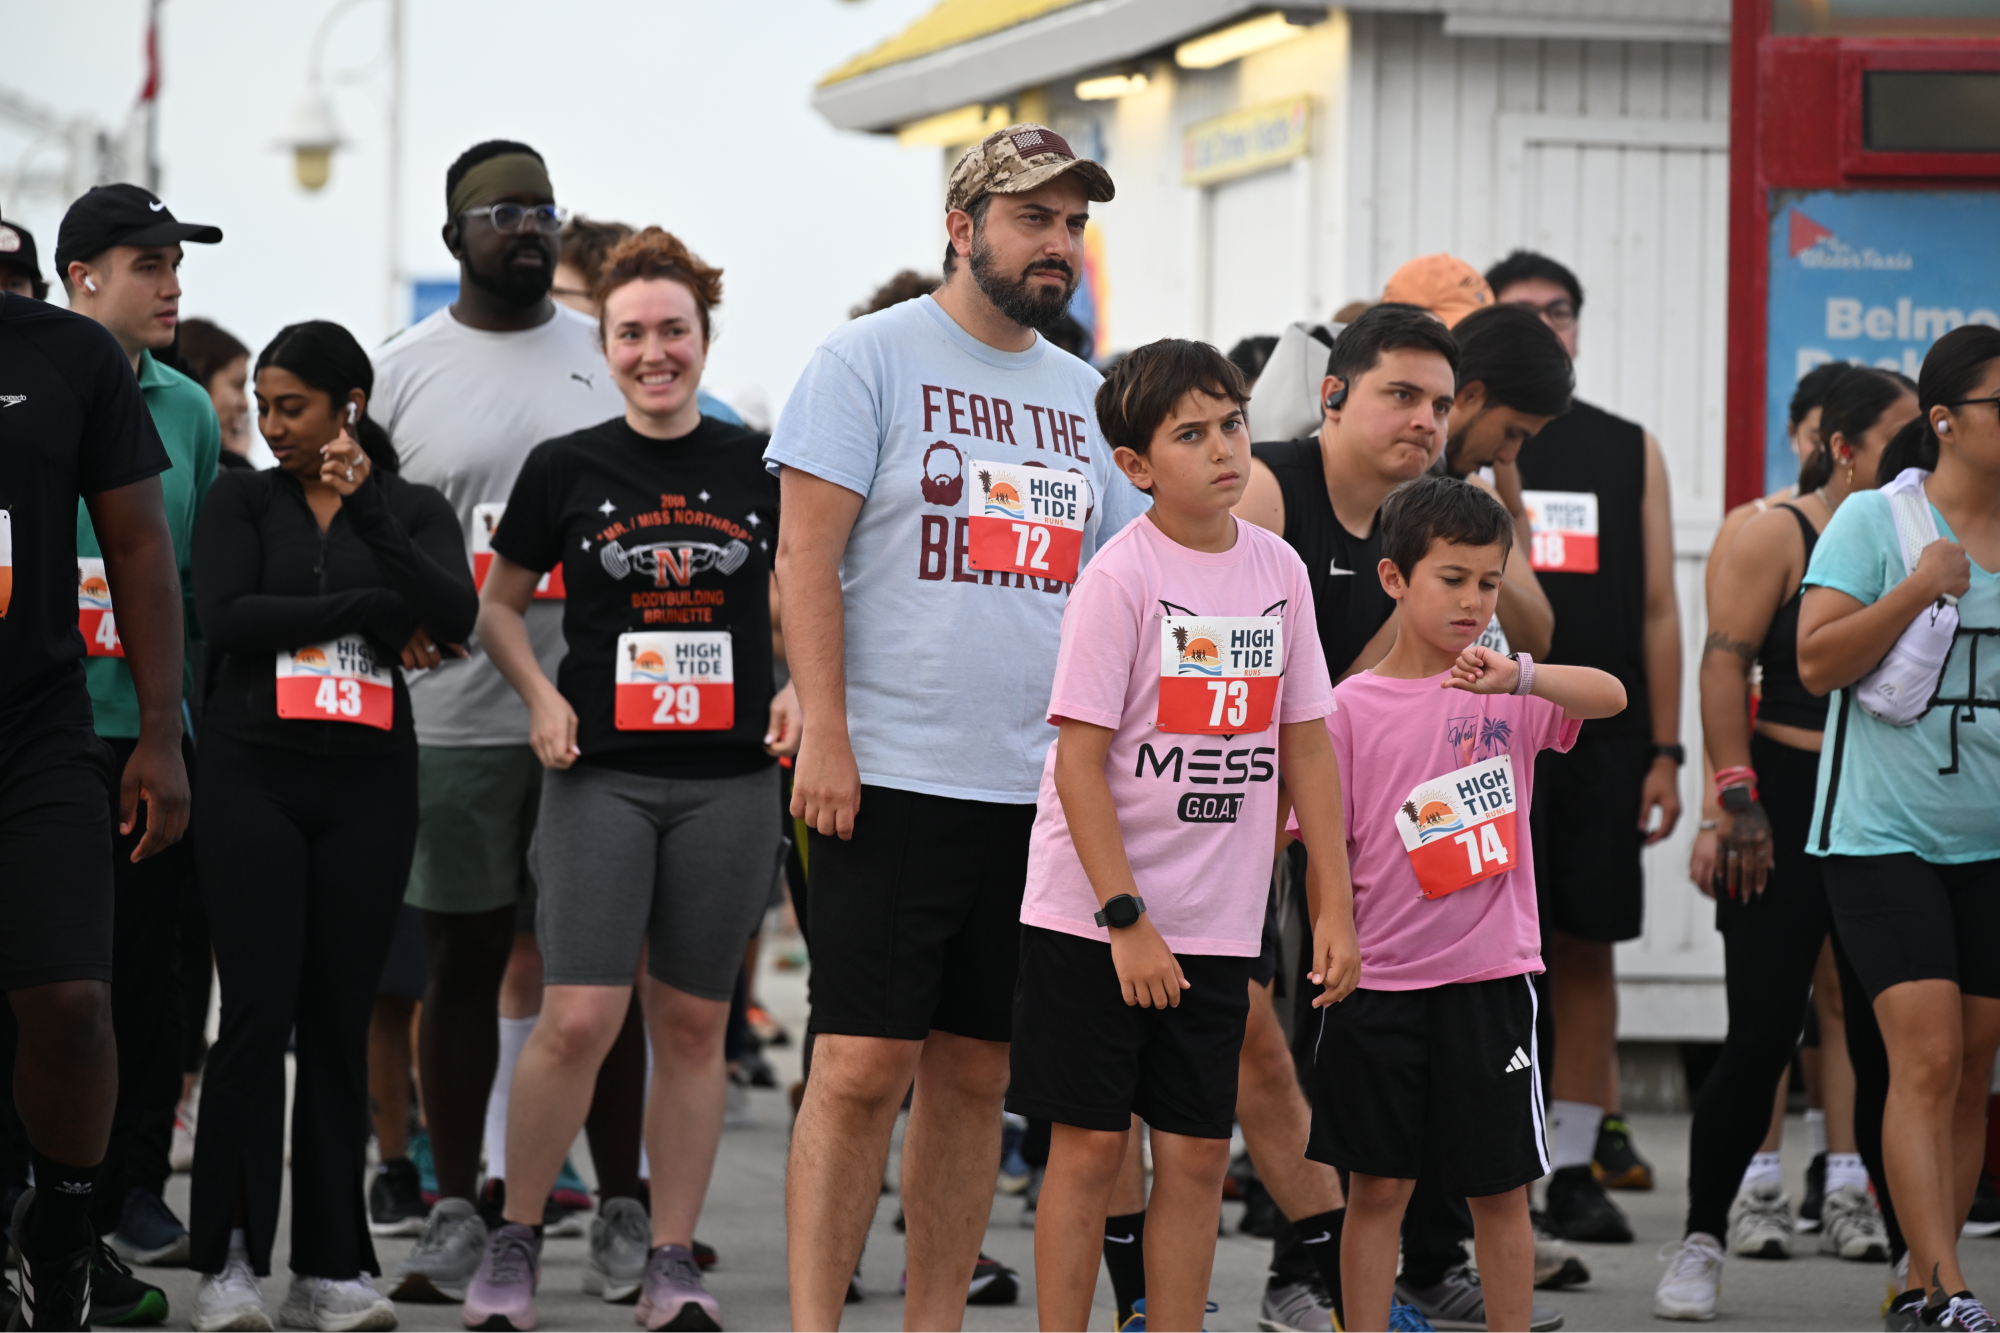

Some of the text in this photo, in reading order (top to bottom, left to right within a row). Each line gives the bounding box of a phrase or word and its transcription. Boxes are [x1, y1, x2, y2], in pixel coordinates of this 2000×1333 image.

[921, 384, 1091, 464] FEAR THE
[1029, 478, 1077, 502] HIGH
[637, 510, 671, 528] MISS
[1030, 497, 1077, 521] TIDE
[1045, 517, 1064, 526] RUNS
[1012, 523, 1051, 571] 72
[652, 548, 692, 587] N
[631, 590, 725, 608] BODYBUILDING
[95, 611, 121, 650] 4
[1230, 629, 1274, 648] HIGH
[676, 643, 722, 659] HIGH
[1230, 649, 1273, 668] TIDE
[339, 656, 380, 678] TIDE
[676, 660, 721, 675] TIDE
[1244, 669, 1261, 677] RUNS
[315, 678, 362, 717] 43
[652, 684, 700, 725] 29
[1207, 680, 1249, 727] 73
[1448, 719, 1476, 747] West
[1456, 768, 1508, 799] HIGH
[1463, 786, 1513, 816] TIDE
[1485, 807, 1506, 819] RUNS
[1453, 822, 1508, 875] 74
